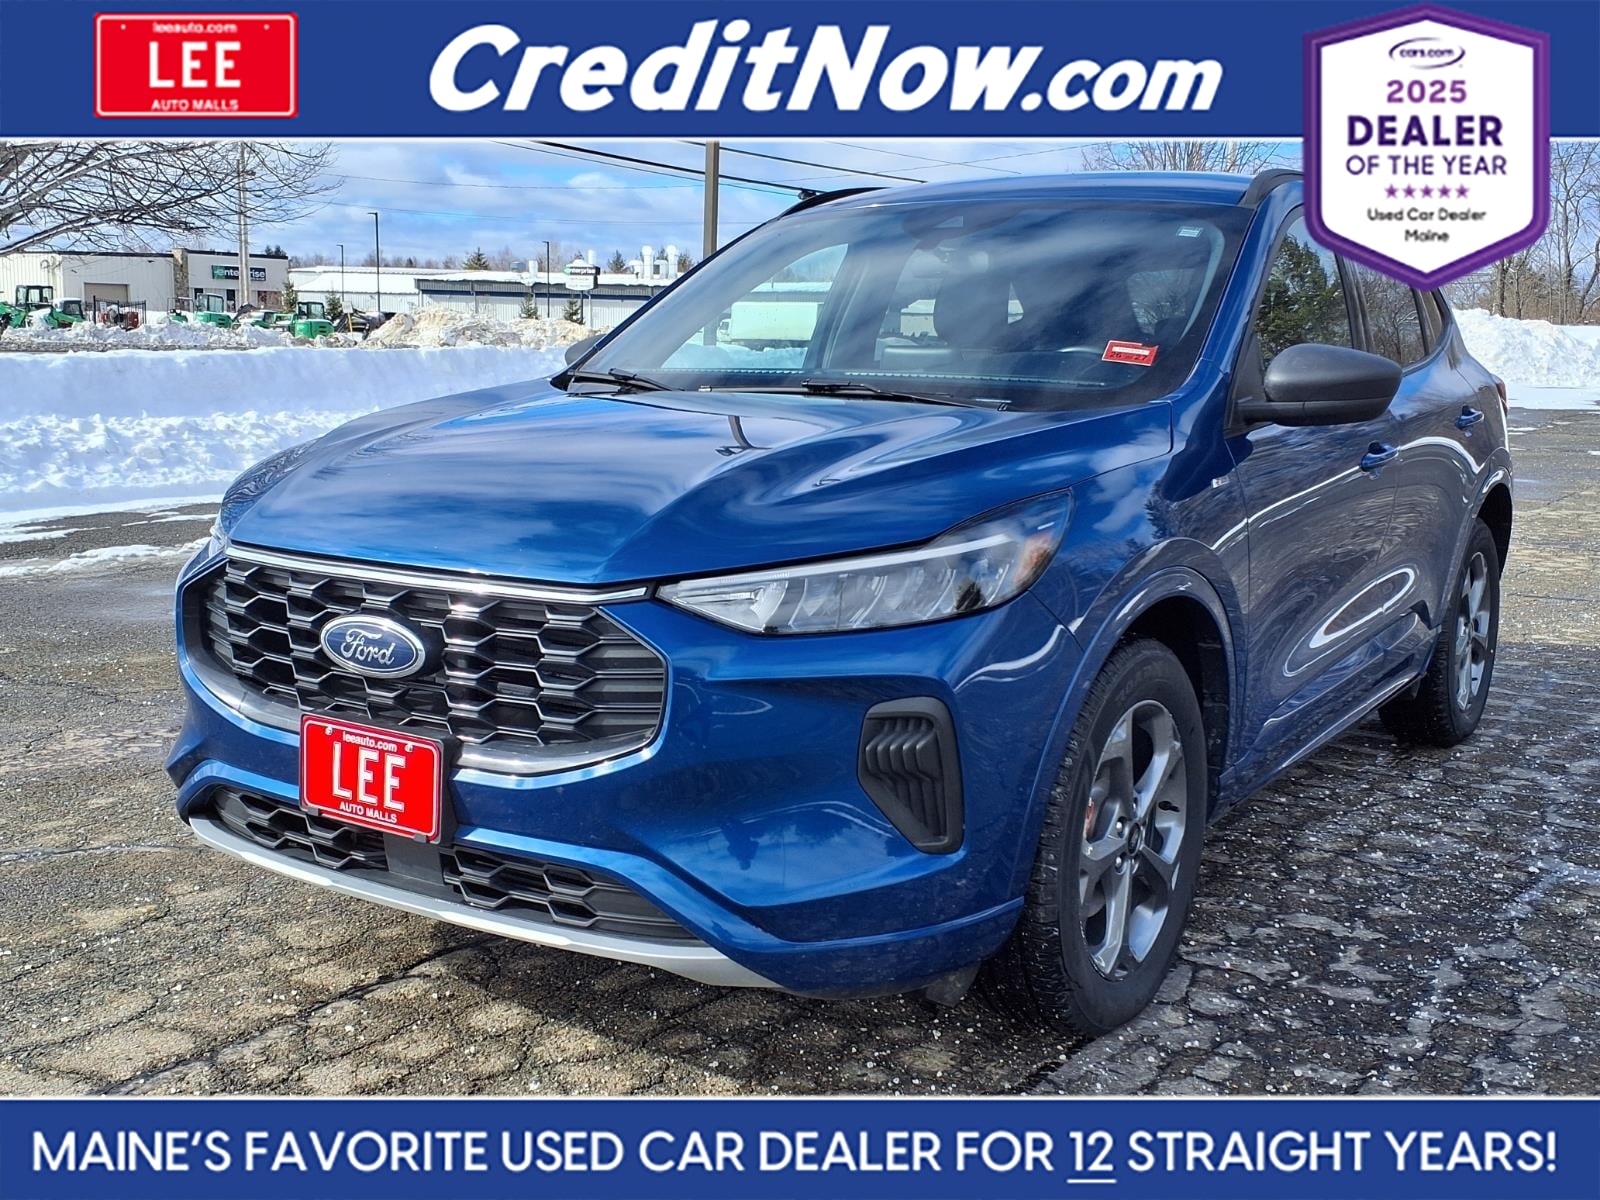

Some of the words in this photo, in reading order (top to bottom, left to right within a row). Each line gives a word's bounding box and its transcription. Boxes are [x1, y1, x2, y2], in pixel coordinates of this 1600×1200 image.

[340, 628, 396, 666] Ford
[342, 731, 398, 753] leeauto.com
[332, 742, 407, 812] LEE
[339, 801, 364, 816] AUTO
[366, 806, 398, 824] MALLS
